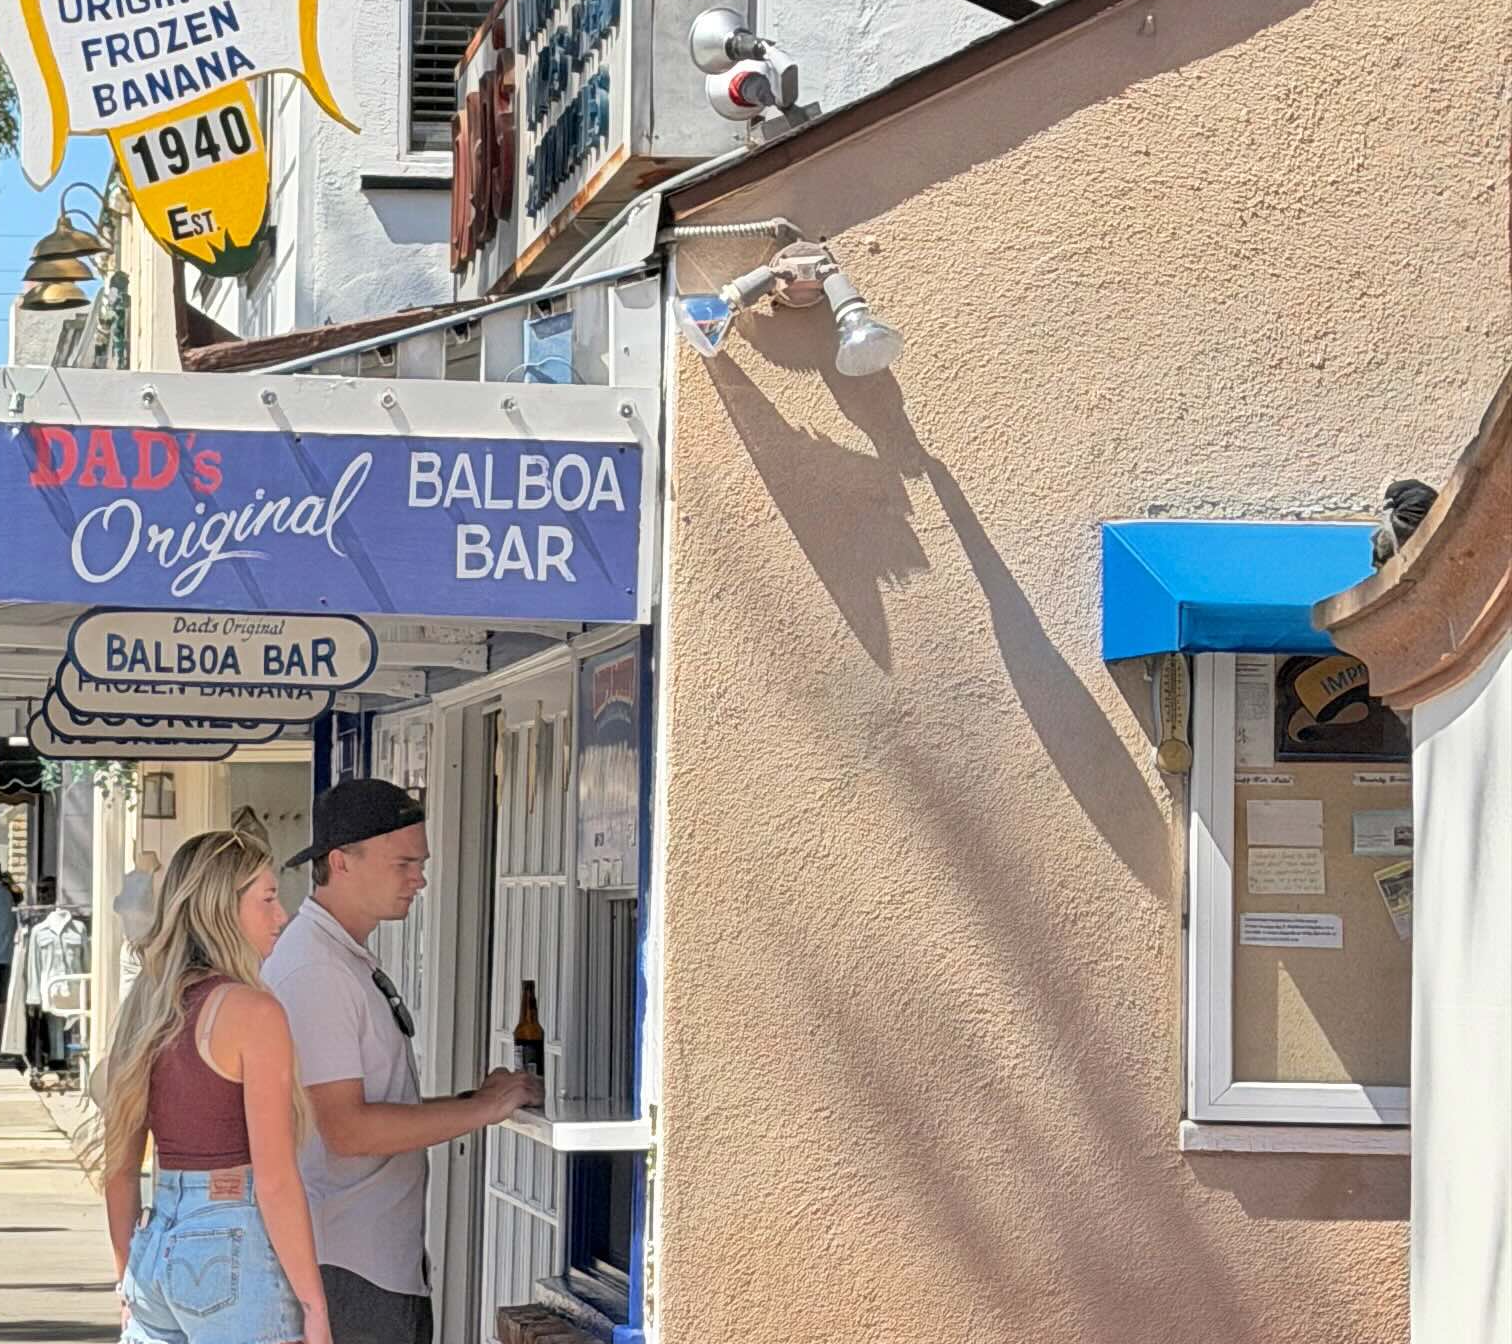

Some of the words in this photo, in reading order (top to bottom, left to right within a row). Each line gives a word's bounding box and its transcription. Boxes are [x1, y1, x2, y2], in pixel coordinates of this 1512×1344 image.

[81, 0, 240, 72] FROZEN
[92, 45, 256, 118] BANANA
[131, 105, 252, 184] 1940
[408, 451, 625, 512] BALBOA
[71, 452, 373, 597] Original
[455, 523, 577, 583] BAR
[106, 632, 241, 676] BALBOA
[263, 637, 339, 678] BAR
[222, 616, 286, 642] Original
